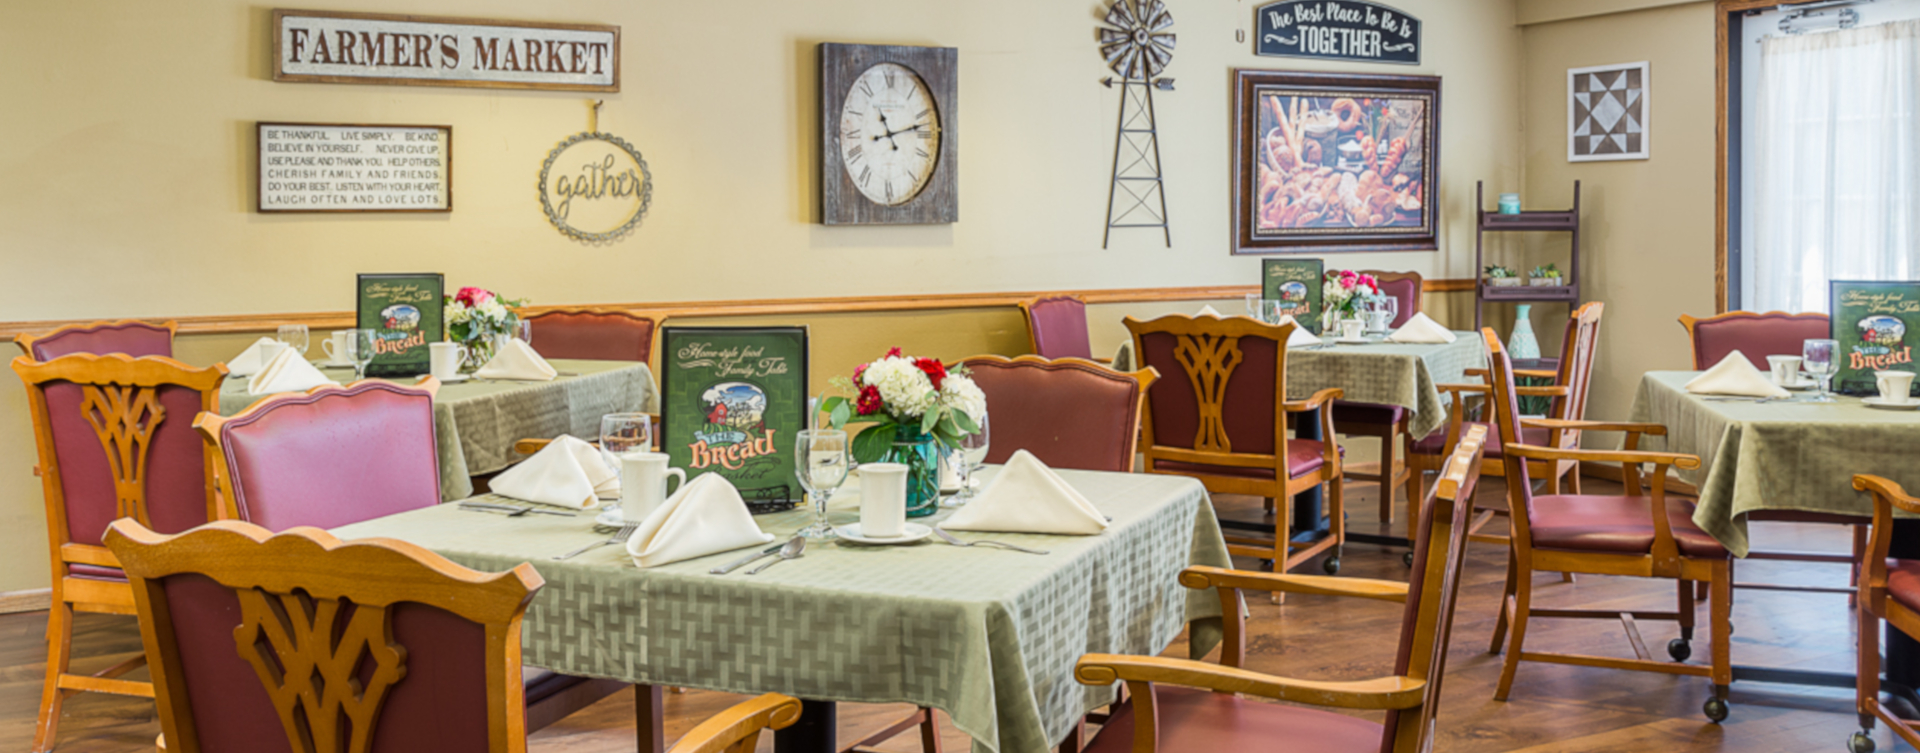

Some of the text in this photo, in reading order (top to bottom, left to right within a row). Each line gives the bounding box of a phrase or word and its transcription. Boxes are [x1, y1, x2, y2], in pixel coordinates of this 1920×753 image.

[1268, 2, 1412, 39] The Best Place To Be Is
[1297, 25, 1381, 57] TOGETHER
[288, 27, 609, 75] FARMER'S MARKET
[267, 130, 279, 140] BE
[341, 131, 360, 141] LIVE
[361, 131, 395, 141] SIMPLY.
[405, 132, 416, 142] BE
[267, 143, 441, 155] BELIEVE IN YOURSELF. NEVER GIVE UP.
[267, 156, 284, 166] USE
[285, 156, 316, 166] PLEASE
[318, 157, 334, 166] AND
[336, 157, 364, 166] THANK
[388, 158, 408, 167] HELP
[267, 169, 442, 180] CHERISH FAMILY AND FRIENDS.
[268, 181, 281, 191] DO
[283, 182, 307, 191] YOUR
[336, 182, 364, 191] LISTEN
[365, 182, 387, 192] WITH
[389, 182, 411, 192] YOUR
[414, 182, 443, 192] HEART.
[556, 153, 645, 222] gather
[268, 194, 442, 204] LAUGH OFTEN AND LOVE LOTS.
[375, 330, 426, 355] Bread
[1848, 345, 1913, 371] Bread
[706, 432, 735, 443] THE
[688, 428, 777, 470] Bread
